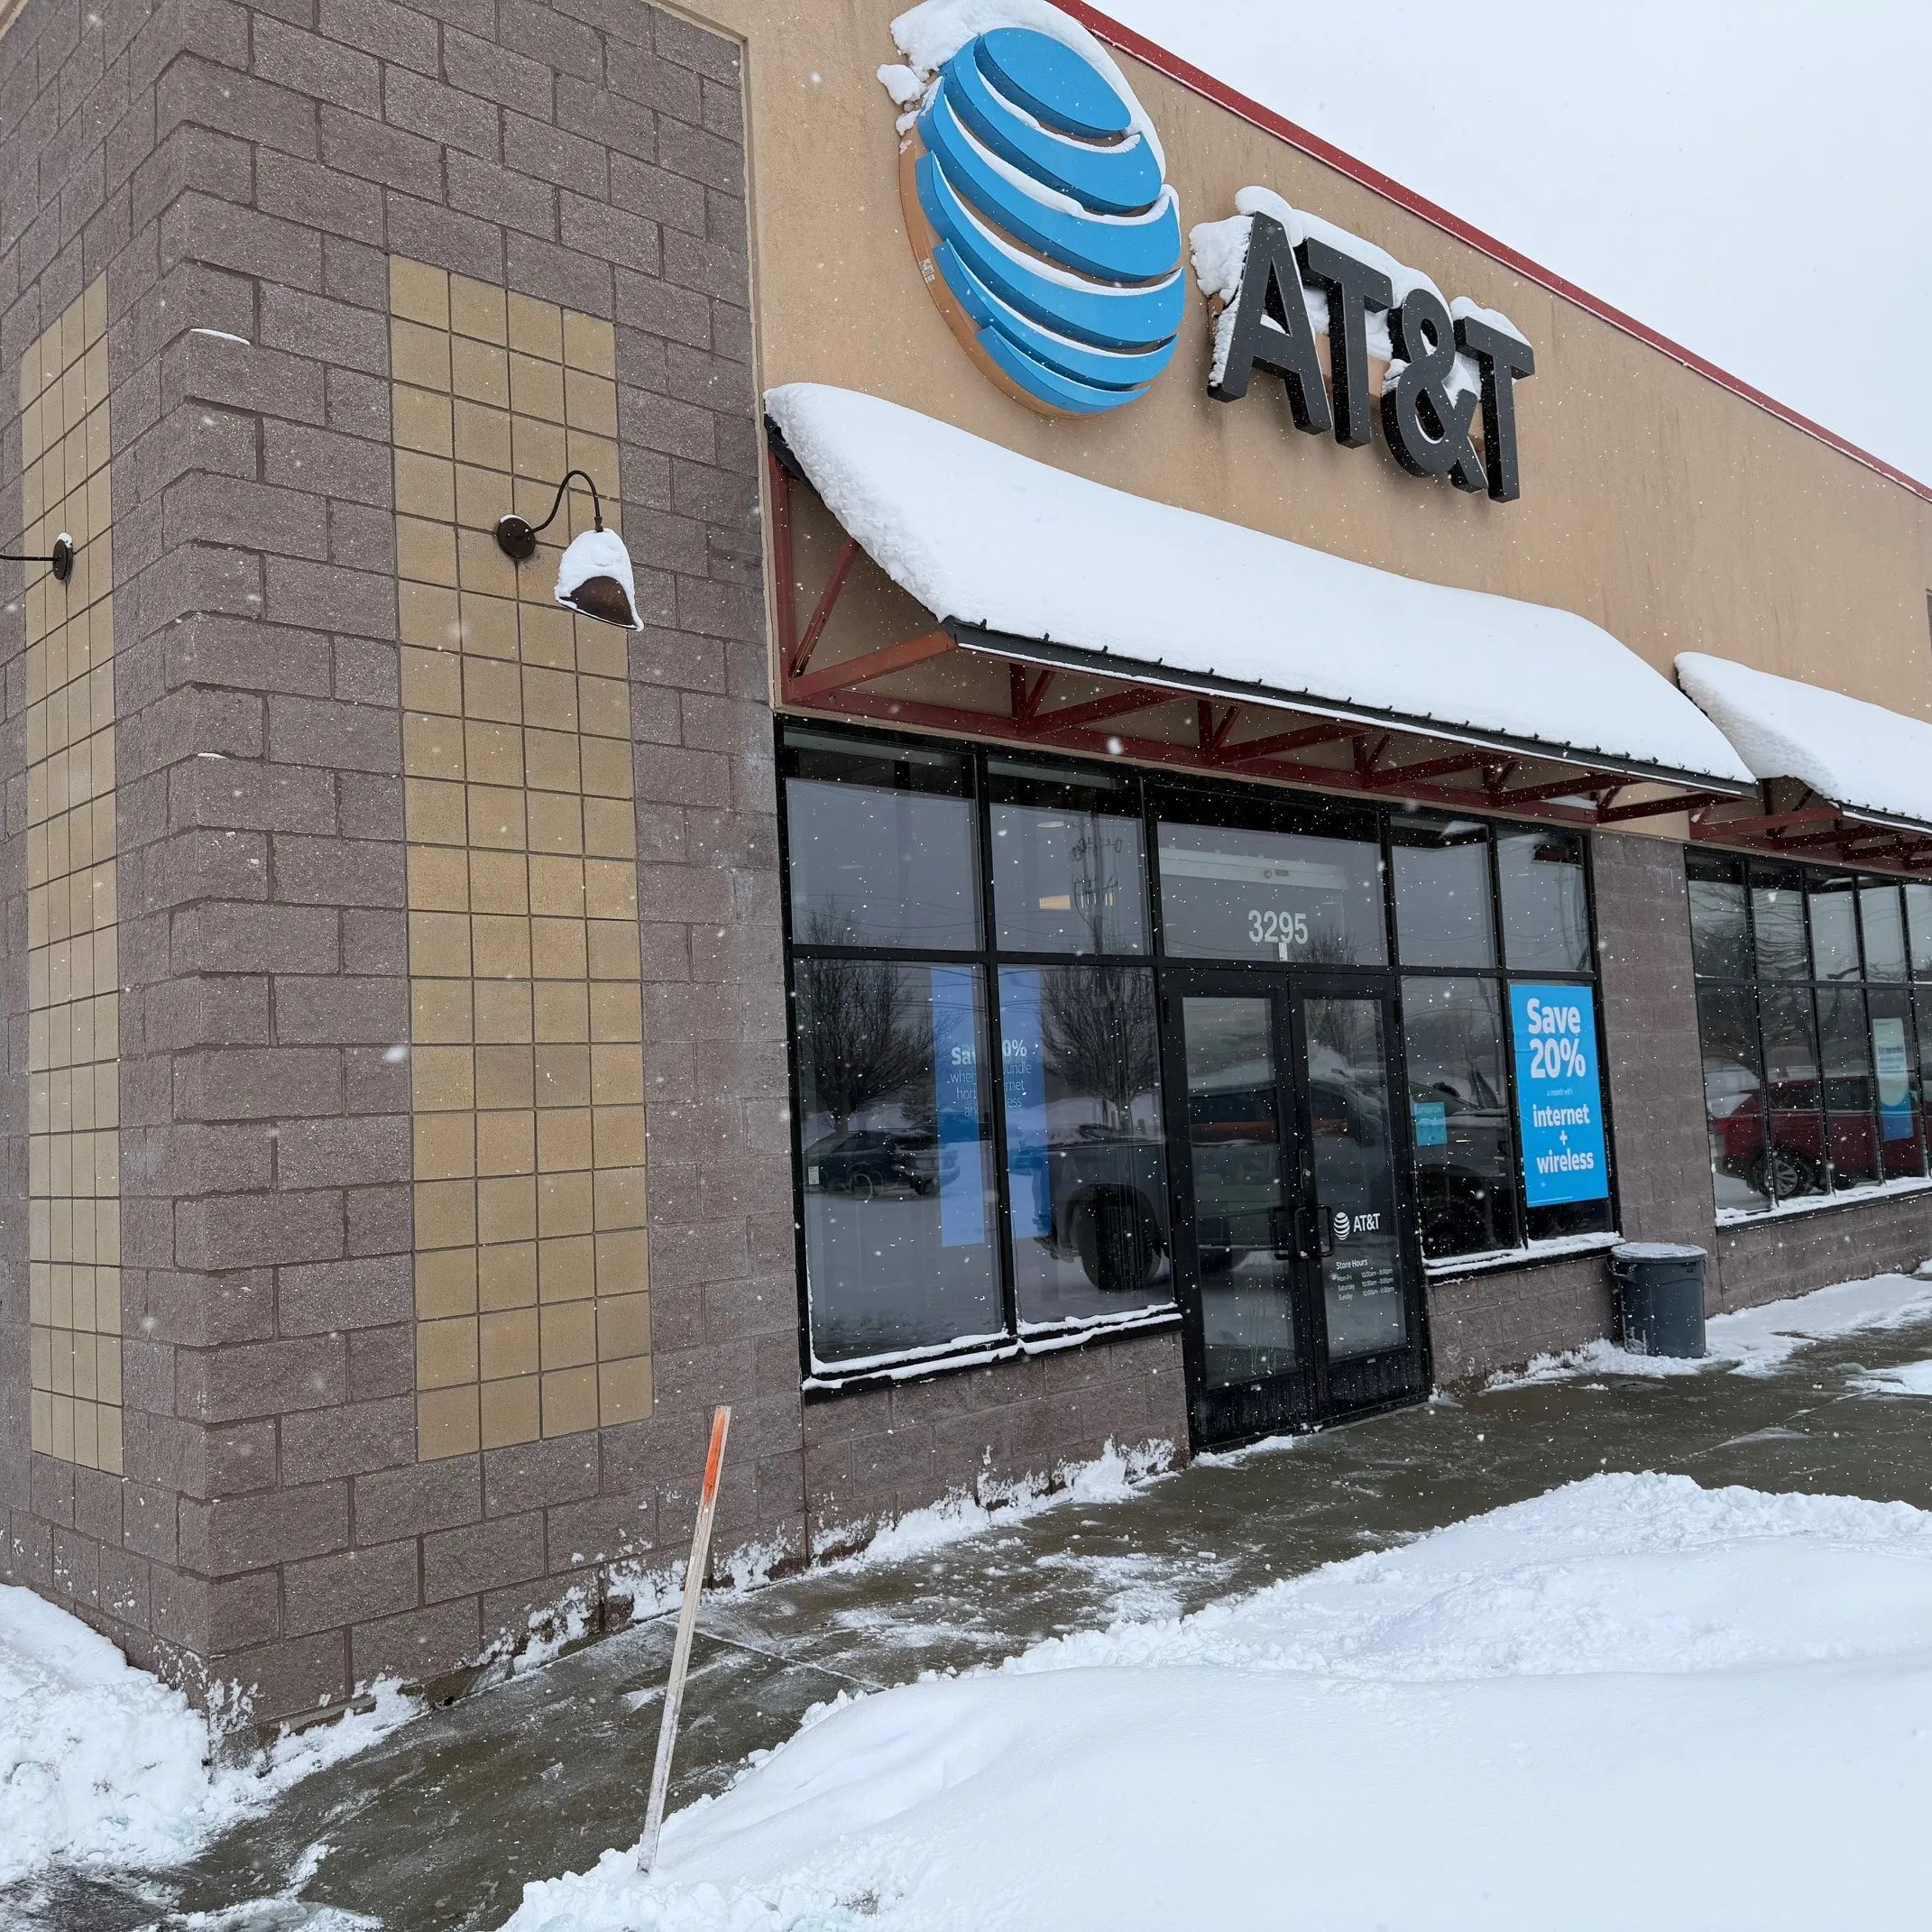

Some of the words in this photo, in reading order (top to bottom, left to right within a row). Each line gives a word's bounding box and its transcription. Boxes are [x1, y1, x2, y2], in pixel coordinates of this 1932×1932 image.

[1209, 210, 1535, 502] AT&T
[1248, 909, 1309, 944] 3295
[1526, 998, 1581, 1035] Save
[1002, 1039, 1027, 1056] 0%
[1529, 1037, 1587, 1079] 20%
[1532, 1103, 1590, 1127] internet
[1559, 1130, 1569, 1145] +
[1536, 1148, 1594, 1173] wireless
[1353, 1213, 1381, 1233] AT&T
[1336, 1261, 1351, 1270] Store
[1351, 1259, 1368, 1268] Hours
[1339, 1293, 1353, 1302] Sunday
